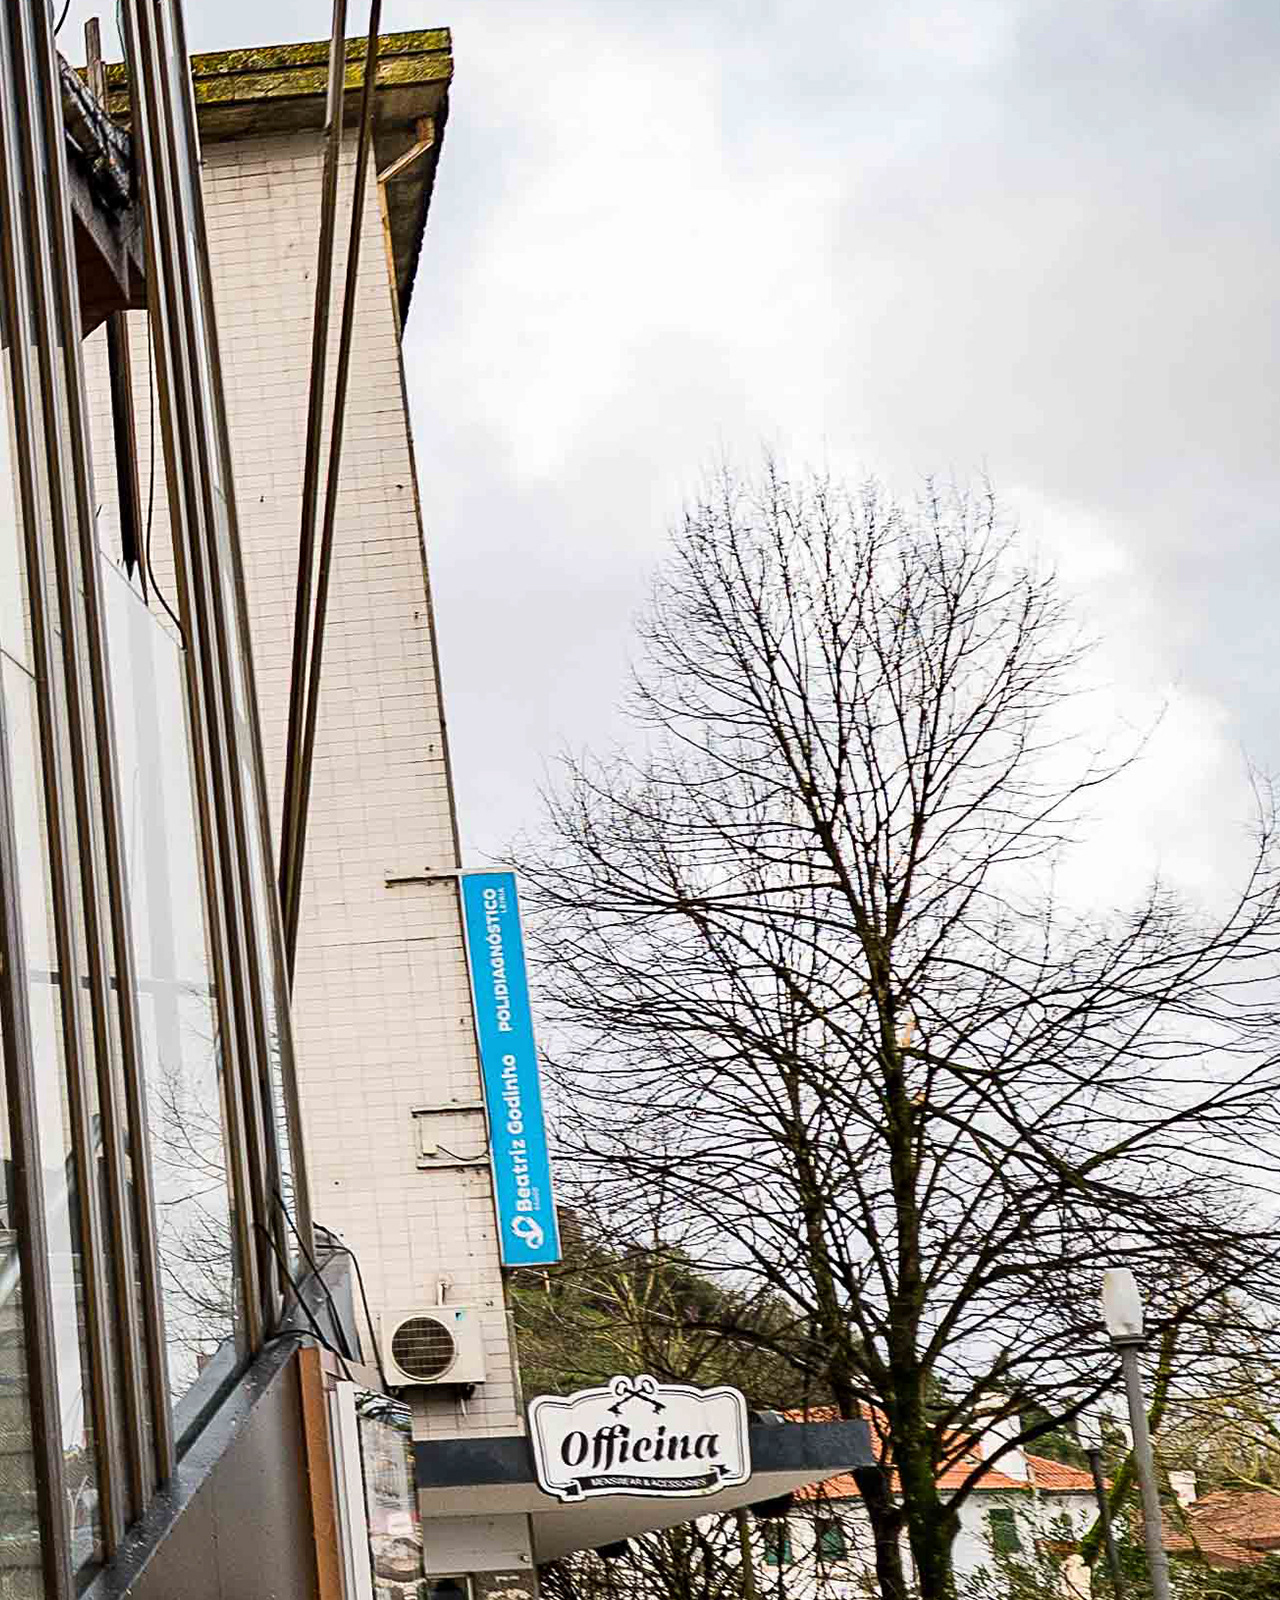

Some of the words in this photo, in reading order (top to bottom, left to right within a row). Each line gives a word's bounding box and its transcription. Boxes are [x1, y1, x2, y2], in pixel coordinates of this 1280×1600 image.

[482, 887, 513, 1033] POLIDIAGNÓSTICO
[501, 1053, 524, 1136] Godinho
[509, 1138, 534, 1212] Beatriz
[560, 1423, 720, 1471] Officina
